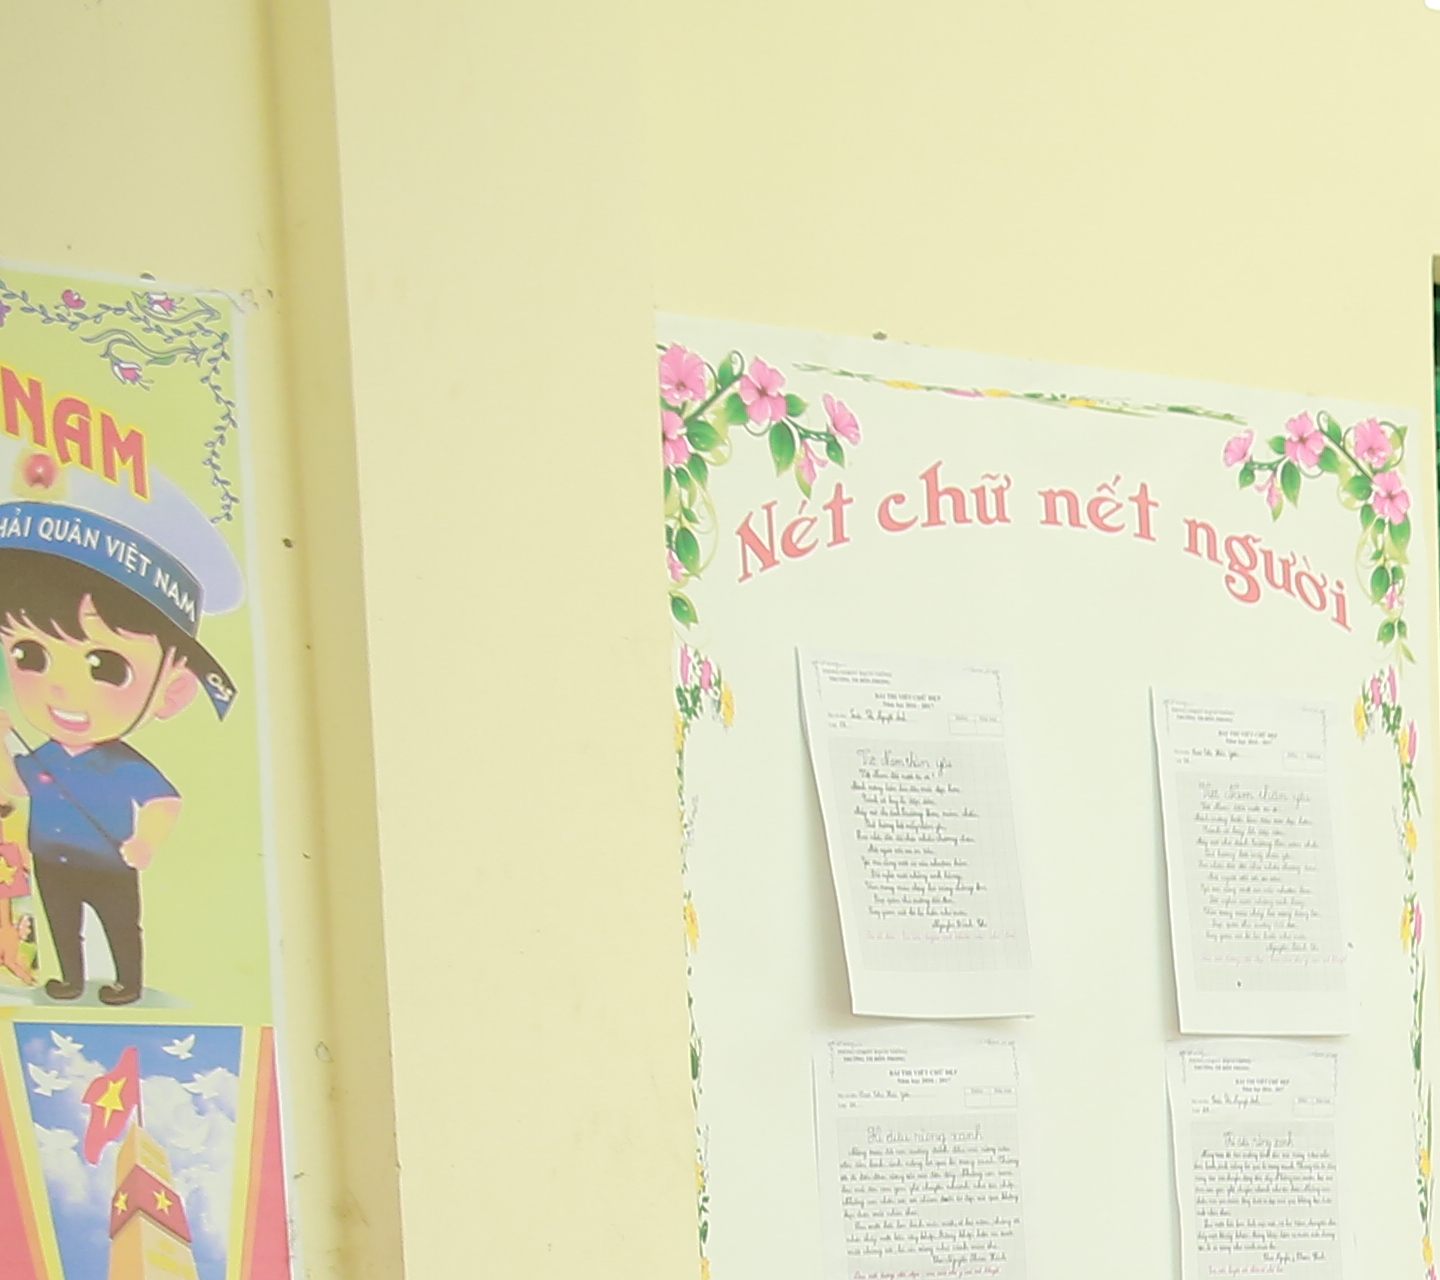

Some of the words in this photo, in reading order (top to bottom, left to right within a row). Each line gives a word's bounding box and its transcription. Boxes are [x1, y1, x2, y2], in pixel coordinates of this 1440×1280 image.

[38, 518, 100, 552] QUÂN
[105, 534, 152, 579] VIỆT
[155, 571, 198, 625] NAM
[735, 480, 853, 583] Nét
[876, 459, 1013, 534] chữ
[1037, 472, 1161, 543] nét
[1182, 513, 1352, 632] người
